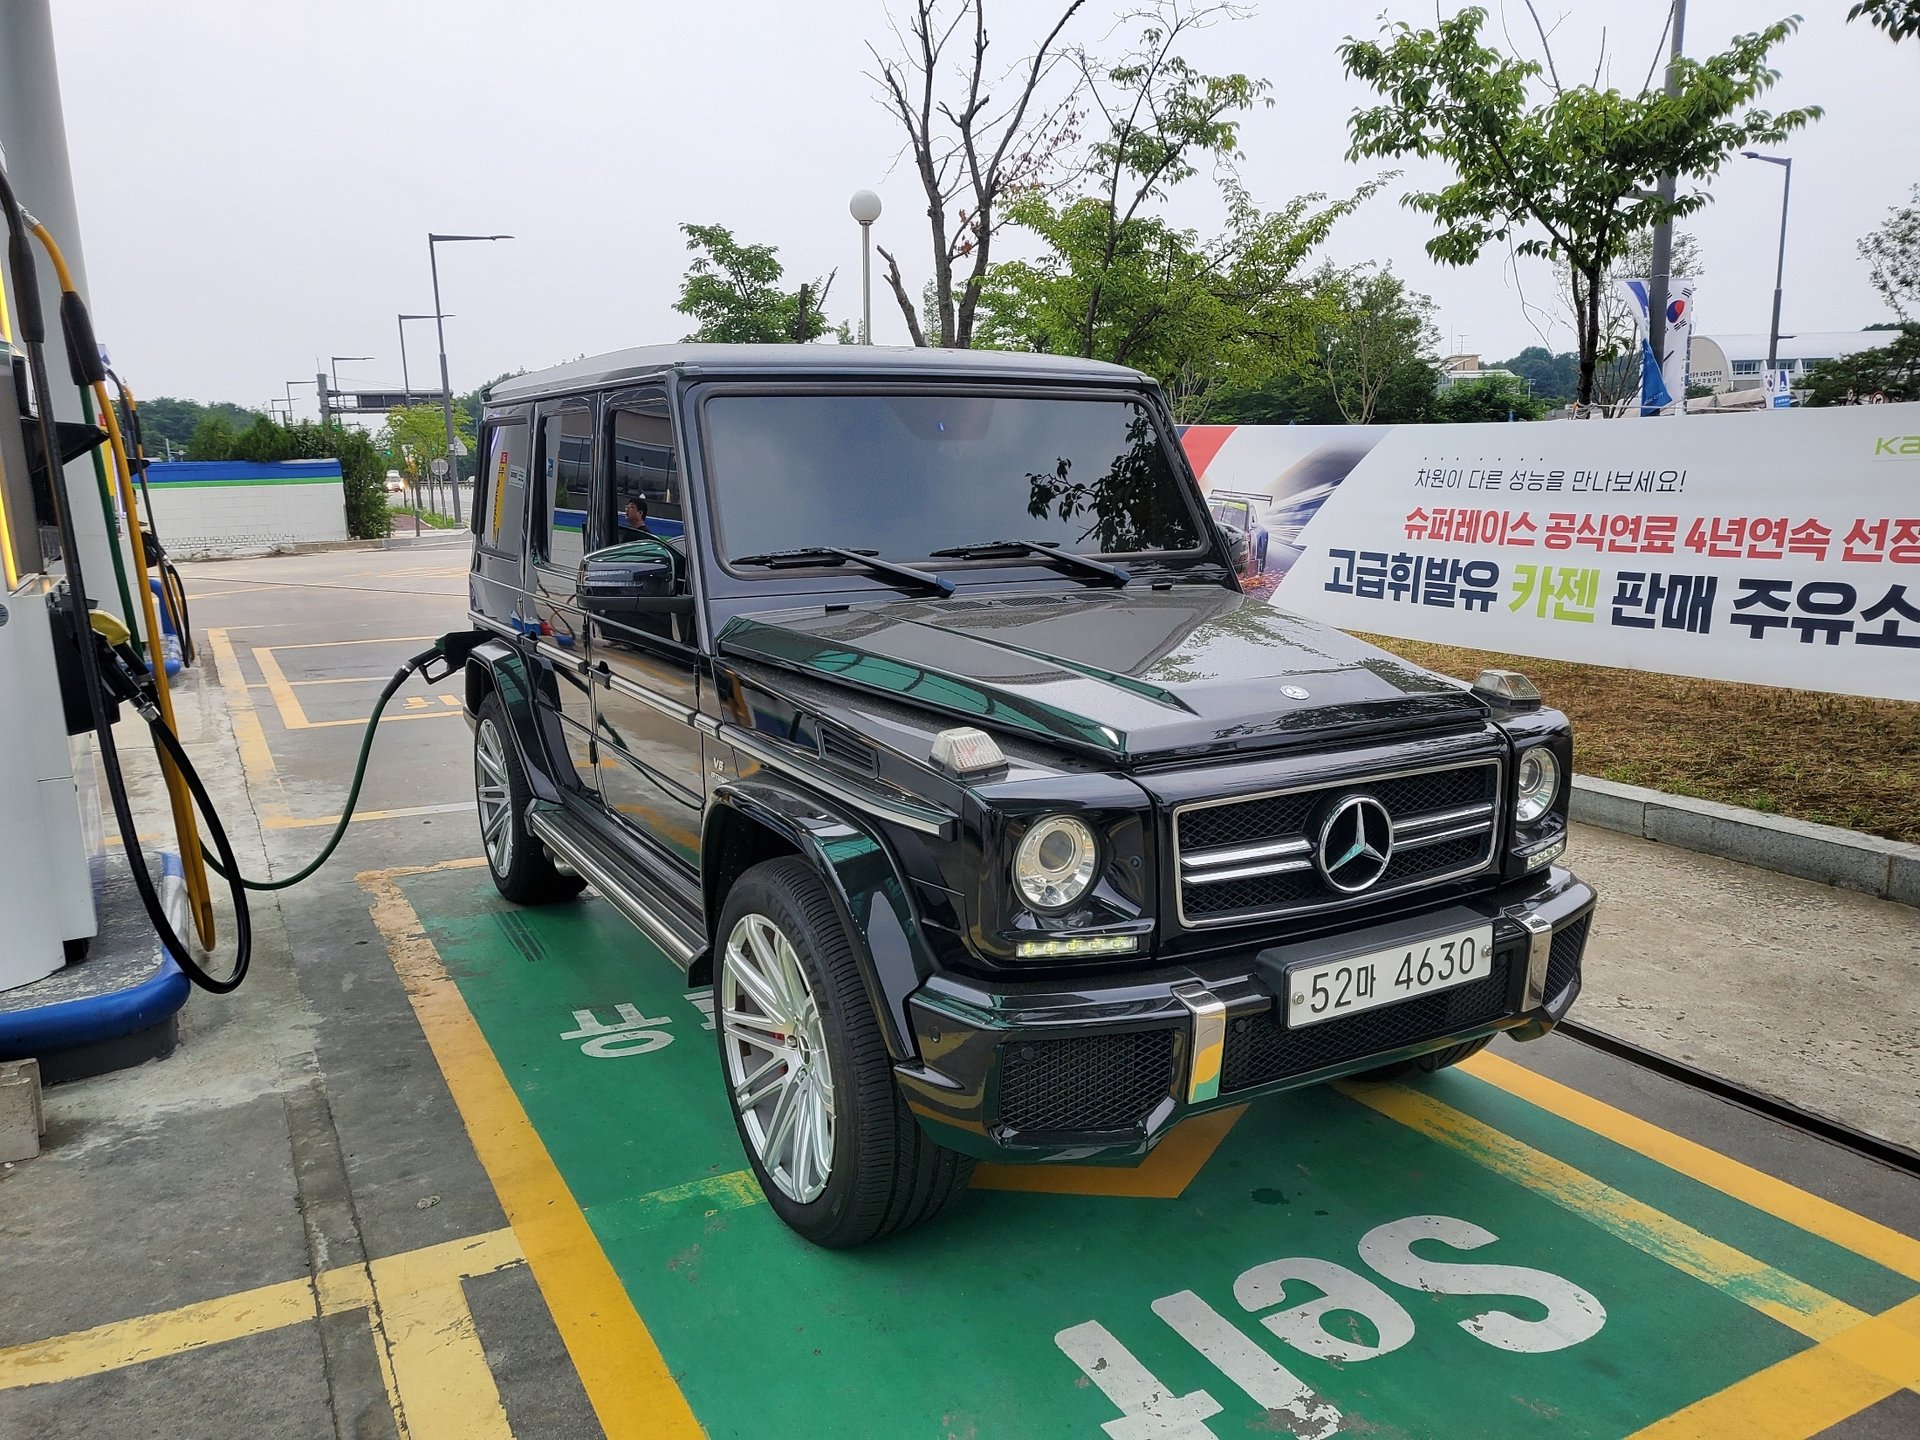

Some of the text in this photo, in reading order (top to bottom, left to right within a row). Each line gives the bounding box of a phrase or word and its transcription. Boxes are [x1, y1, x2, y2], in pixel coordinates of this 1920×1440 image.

[1414, 468, 1687, 492] 차원이 다른 성능을 만나보세요!
[1404, 506, 1920, 565] 슈퍼레이스 공식연료 4년연속 선정
[1324, 548, 1920, 650] 고급휘발유 카젠 판매 주유소
[1310, 936, 1476, 1014] 52마 4630
